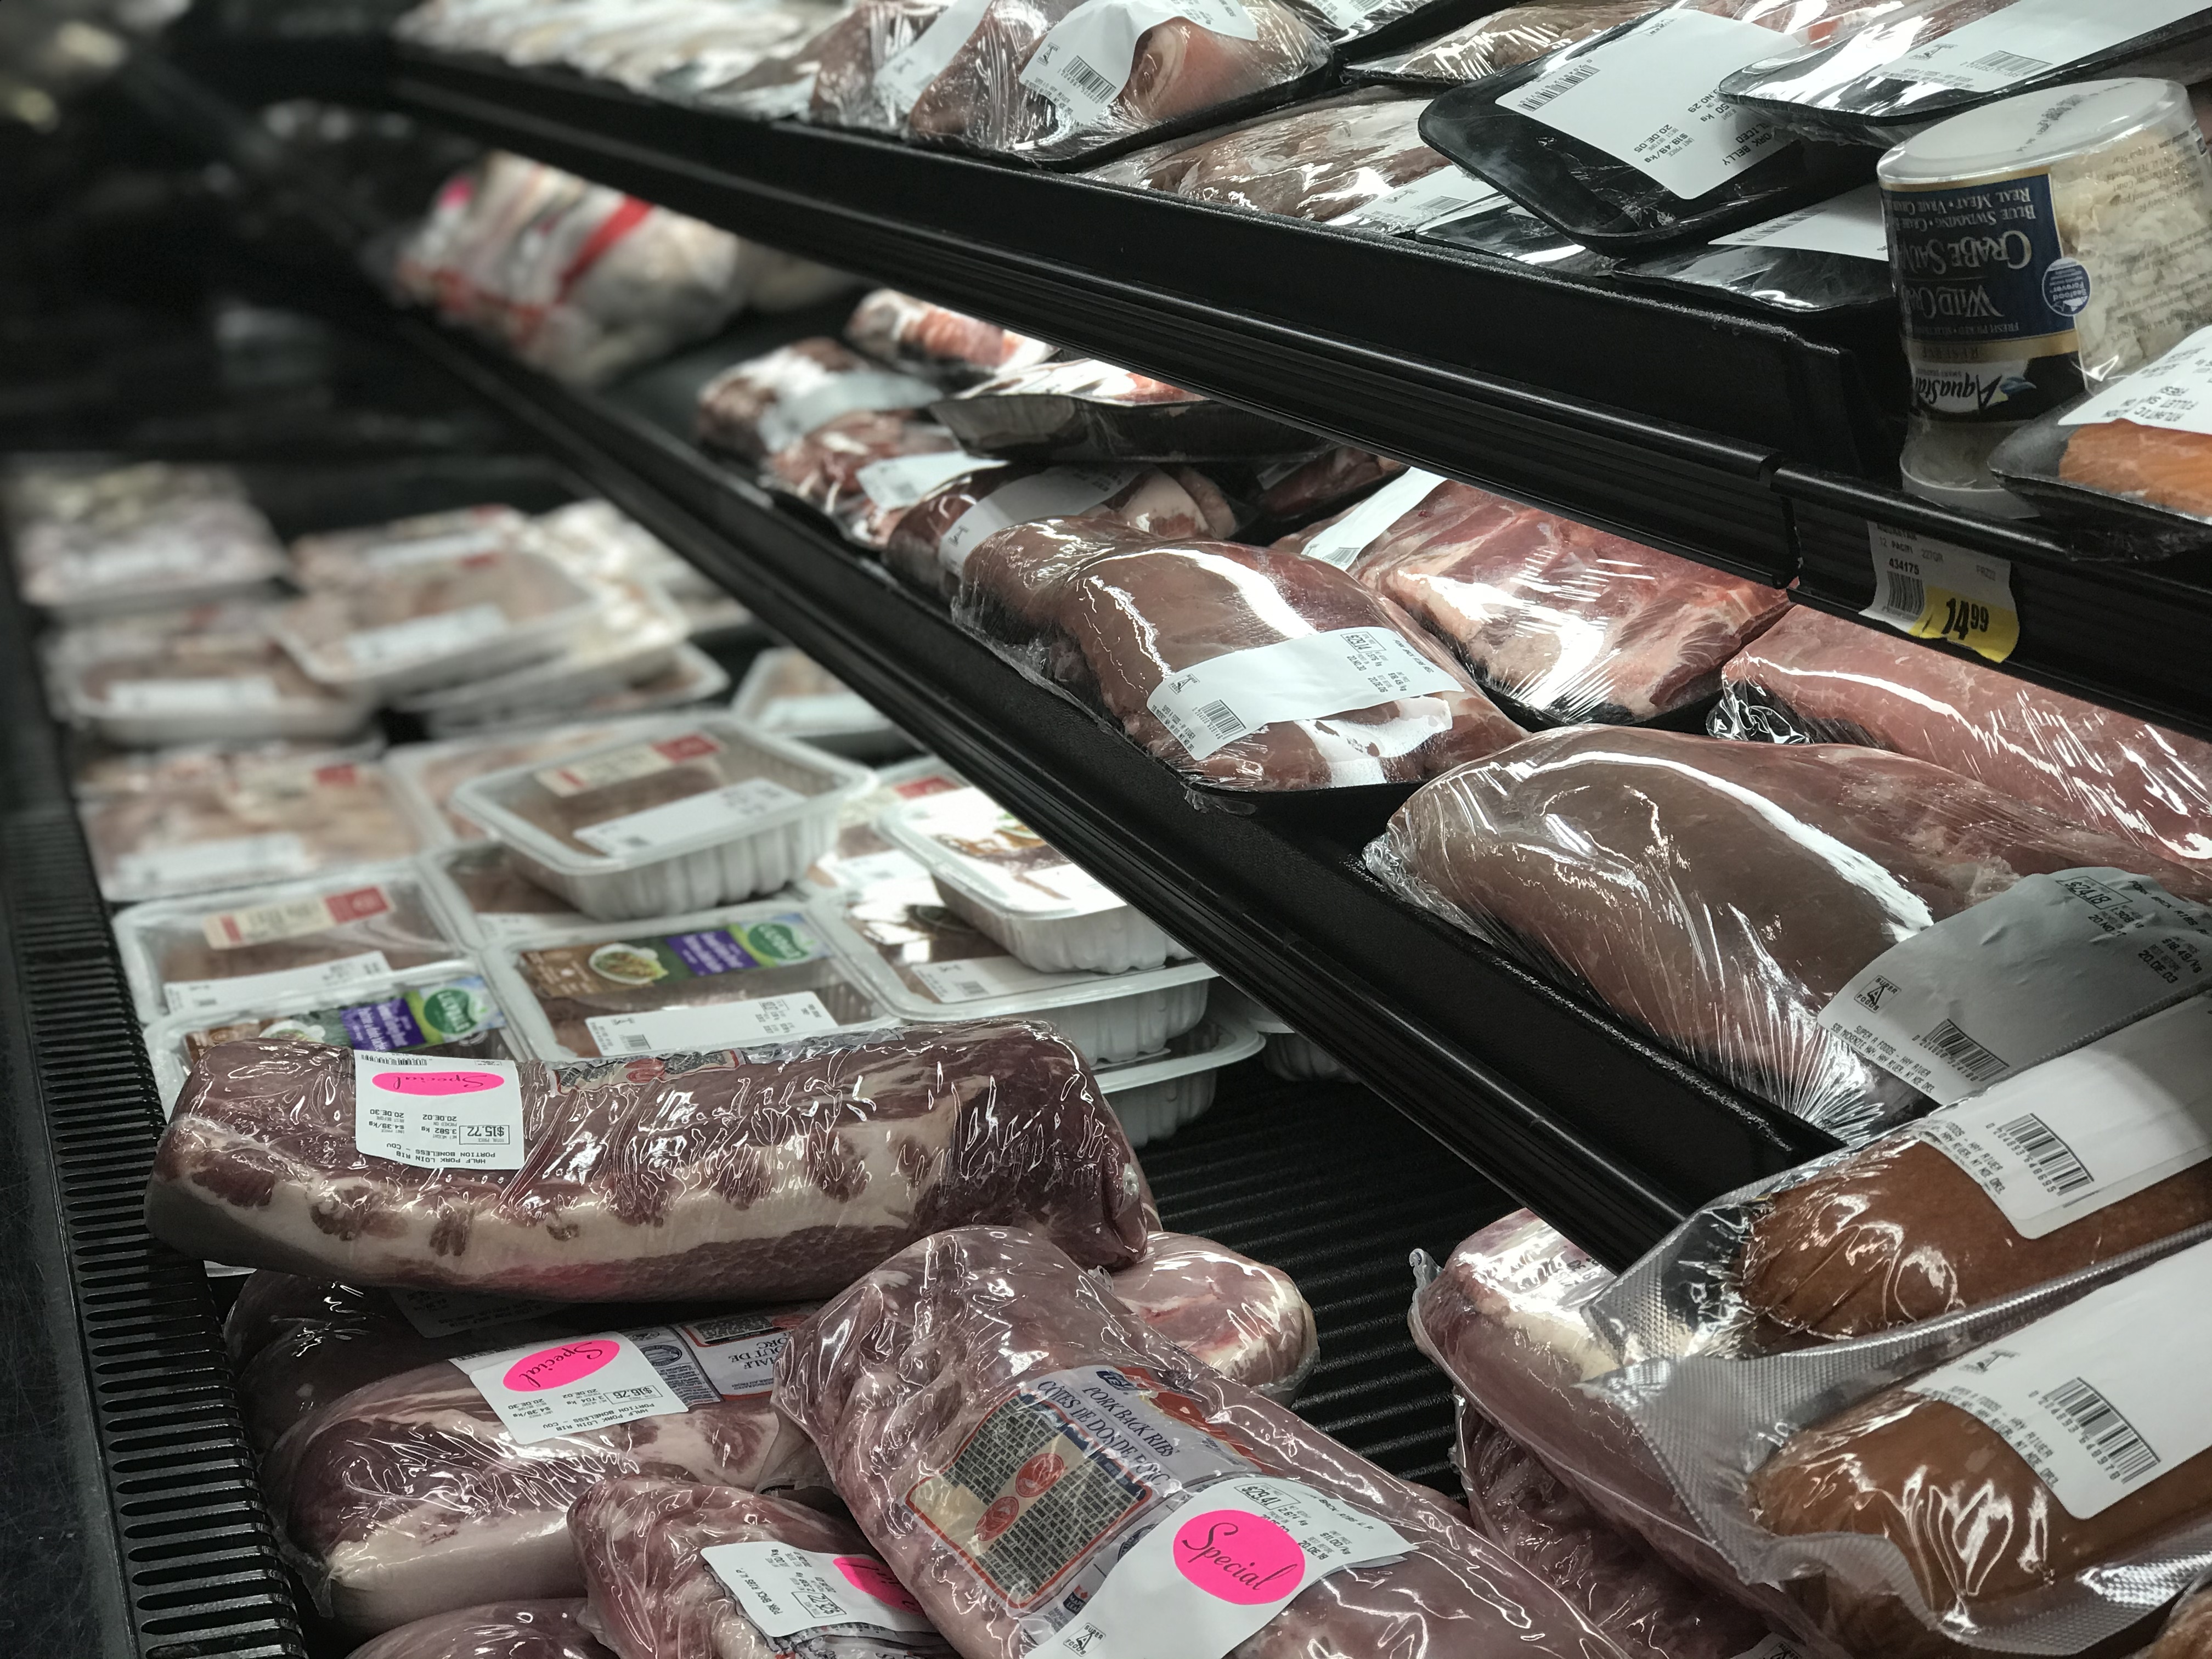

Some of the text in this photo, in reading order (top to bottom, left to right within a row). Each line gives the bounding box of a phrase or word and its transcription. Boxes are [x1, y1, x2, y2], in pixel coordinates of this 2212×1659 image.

[1700, 114, 1715, 122] kg
[1683, 137, 1695, 148] UNIT
[1722, 132, 1774, 166] ORK BELLY
[1955, 193, 1993, 210] MEAT
[1995, 188, 2031, 202] REAL
[1936, 204, 2036, 228] BLUE SWIMMING
[1948, 230, 2032, 269] CRABE
[2053, 281, 2084, 293] Forever
[1938, 285, 2005, 317] WILD
[2053, 289, 2086, 302] Seafood
[1990, 323, 2019, 333] FRESH
[2065, 882, 2112, 904] $24.18
[2162, 938, 2202, 974] $18.49/kg
[2138, 950, 2179, 984] 20.DE.03
[1875, 977, 1898, 995] SUPER
[1857, 994, 1880, 1011] FOODS
[1854, 1025, 1873, 1039] SUPER
[1877, 1040, 1897, 1056] FOODS
[1900, 1056, 1914, 1067] HAY
[1912, 1061, 1932, 1077] RIVER
[1876, 1051, 1889, 1062] HAY
[1903, 1070, 1914, 1079] NT
[392, 1074, 488, 1090] Special
[370, 1109, 404, 1118] 20.DE.30
[369, 1120, 405, 1130] $4.39/kg
[467, 1126, 505, 1137] $15.72
[396, 1151, 411, 1160] RIB
[415, 1149, 455, 1157] BONELESS
[756, 1335, 788, 1350] ORC
[728, 1347, 781, 1363] OUT DE
[519, 1342, 603, 1388] Special
[612, 1386, 653, 1399] $16.26
[507, 1398, 544, 1410] 20.DE.30
[512, 1406, 551, 1418] $4.39/kg
[618, 1403, 655, 1413] PORTION
[573, 1410, 614, 1423] BONELESS
[576, 1420, 598, 1428] LOIN
[603, 1413, 624, 1423] PORK
[1037, 1381, 1081, 1408] CÔTES
[1070, 1408, 1096, 1423] DE
[1112, 1439, 1138, 1458] DE
[1082, 1387, 1173, 1457] PORK BACK RIBS
[1242, 1486, 1282, 1506] $29.41
[1298, 1540, 1329, 1560] 20.DE.18
[1319, 1532, 1351, 1555] $11.00/kg
[1182, 1522, 1298, 1590] Special
[755, 1591, 772, 1604] BACK
[1084, 1624, 1103, 1640] SUPER
[1065, 1639, 1086, 1655] FOODS
